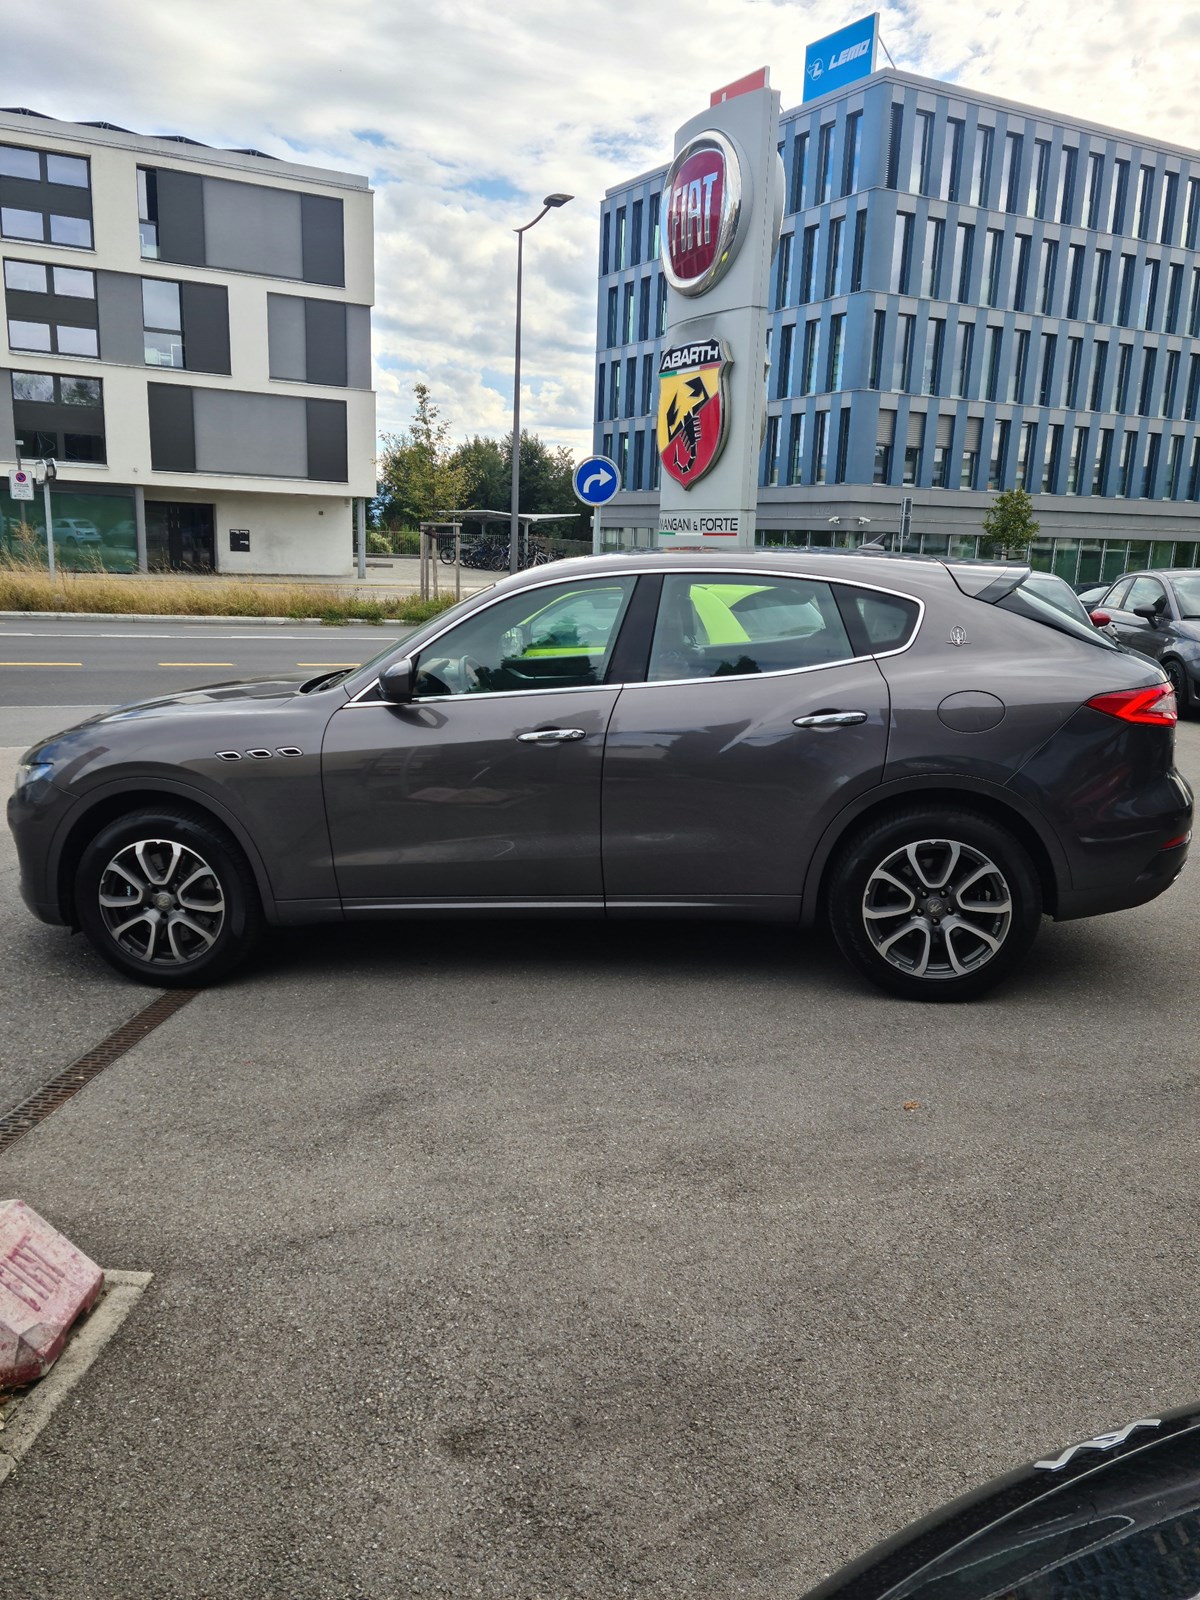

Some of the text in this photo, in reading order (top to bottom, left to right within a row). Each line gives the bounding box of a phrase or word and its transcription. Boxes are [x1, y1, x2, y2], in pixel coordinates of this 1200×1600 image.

[828, 38, 871, 70] LEMO
[672, 172, 718, 256] FIAT
[662, 346, 719, 370] ABARTH
[700, 518, 738, 531] FORTE
